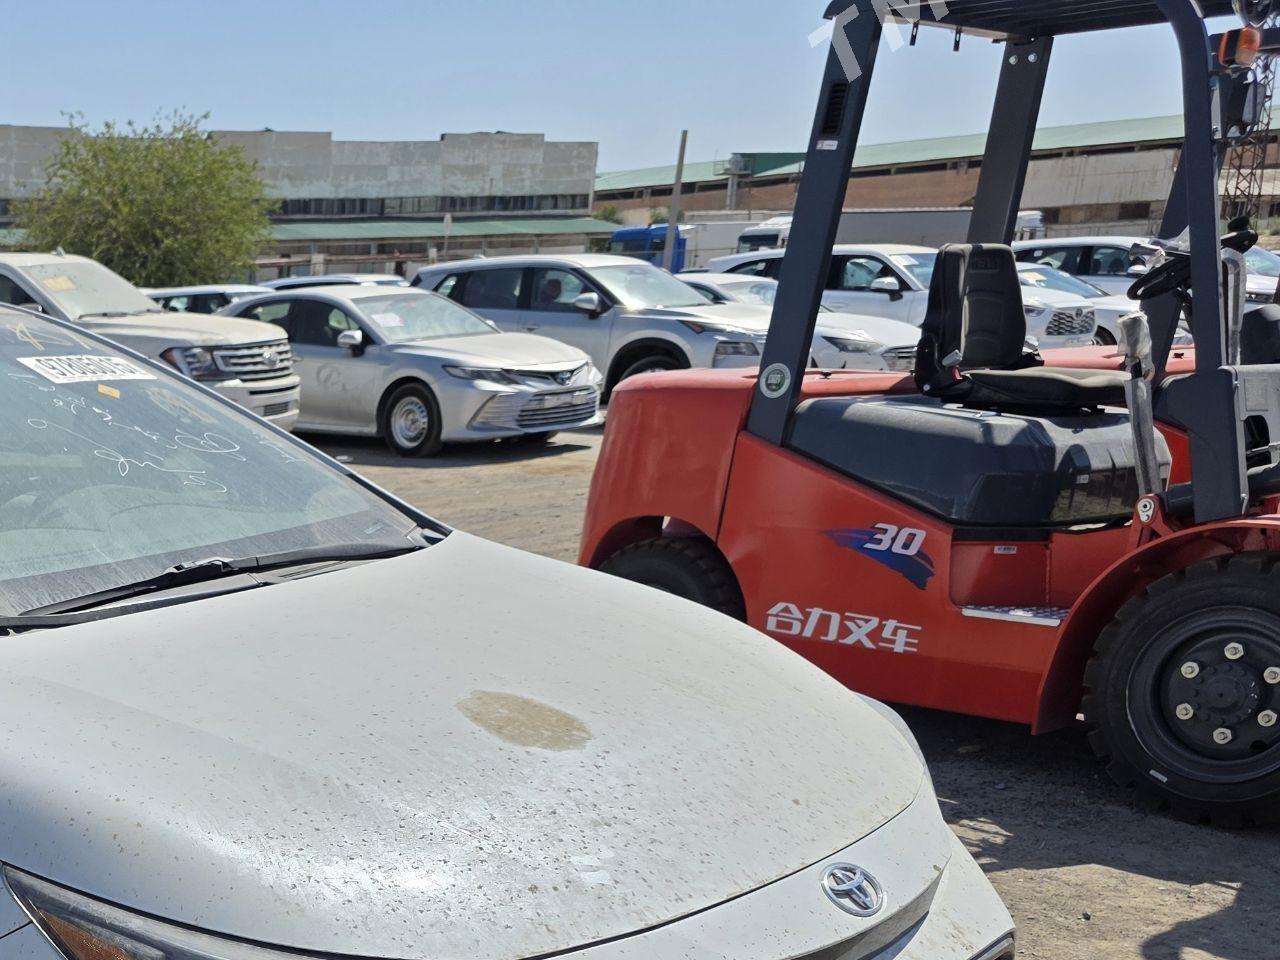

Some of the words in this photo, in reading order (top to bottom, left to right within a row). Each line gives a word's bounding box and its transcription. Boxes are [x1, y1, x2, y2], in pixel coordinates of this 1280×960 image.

[863, 522, 927, 556] 30
[766, 601, 922, 653] 合力叉车
